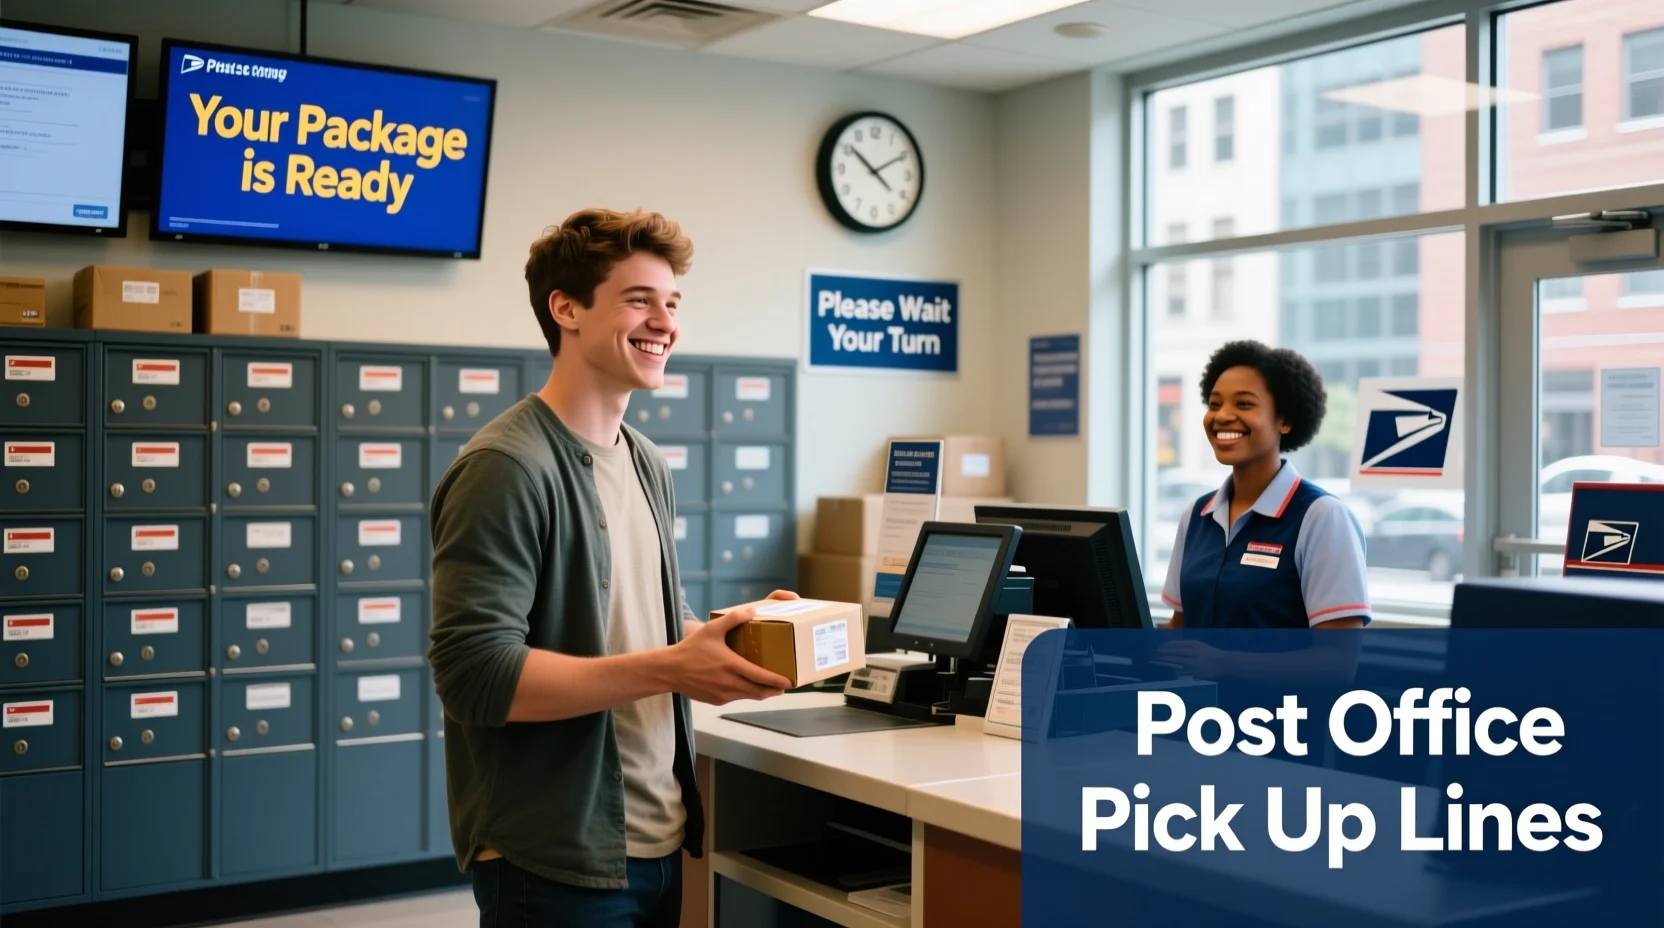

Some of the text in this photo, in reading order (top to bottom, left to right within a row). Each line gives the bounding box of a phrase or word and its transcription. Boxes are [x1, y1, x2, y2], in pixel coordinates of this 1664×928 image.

[189, 93, 468, 169] Your Package
[241, 147, 415, 215] is Ready
[818, 290, 951, 324] Please Wait
[827, 323, 941, 355] Your Turn
